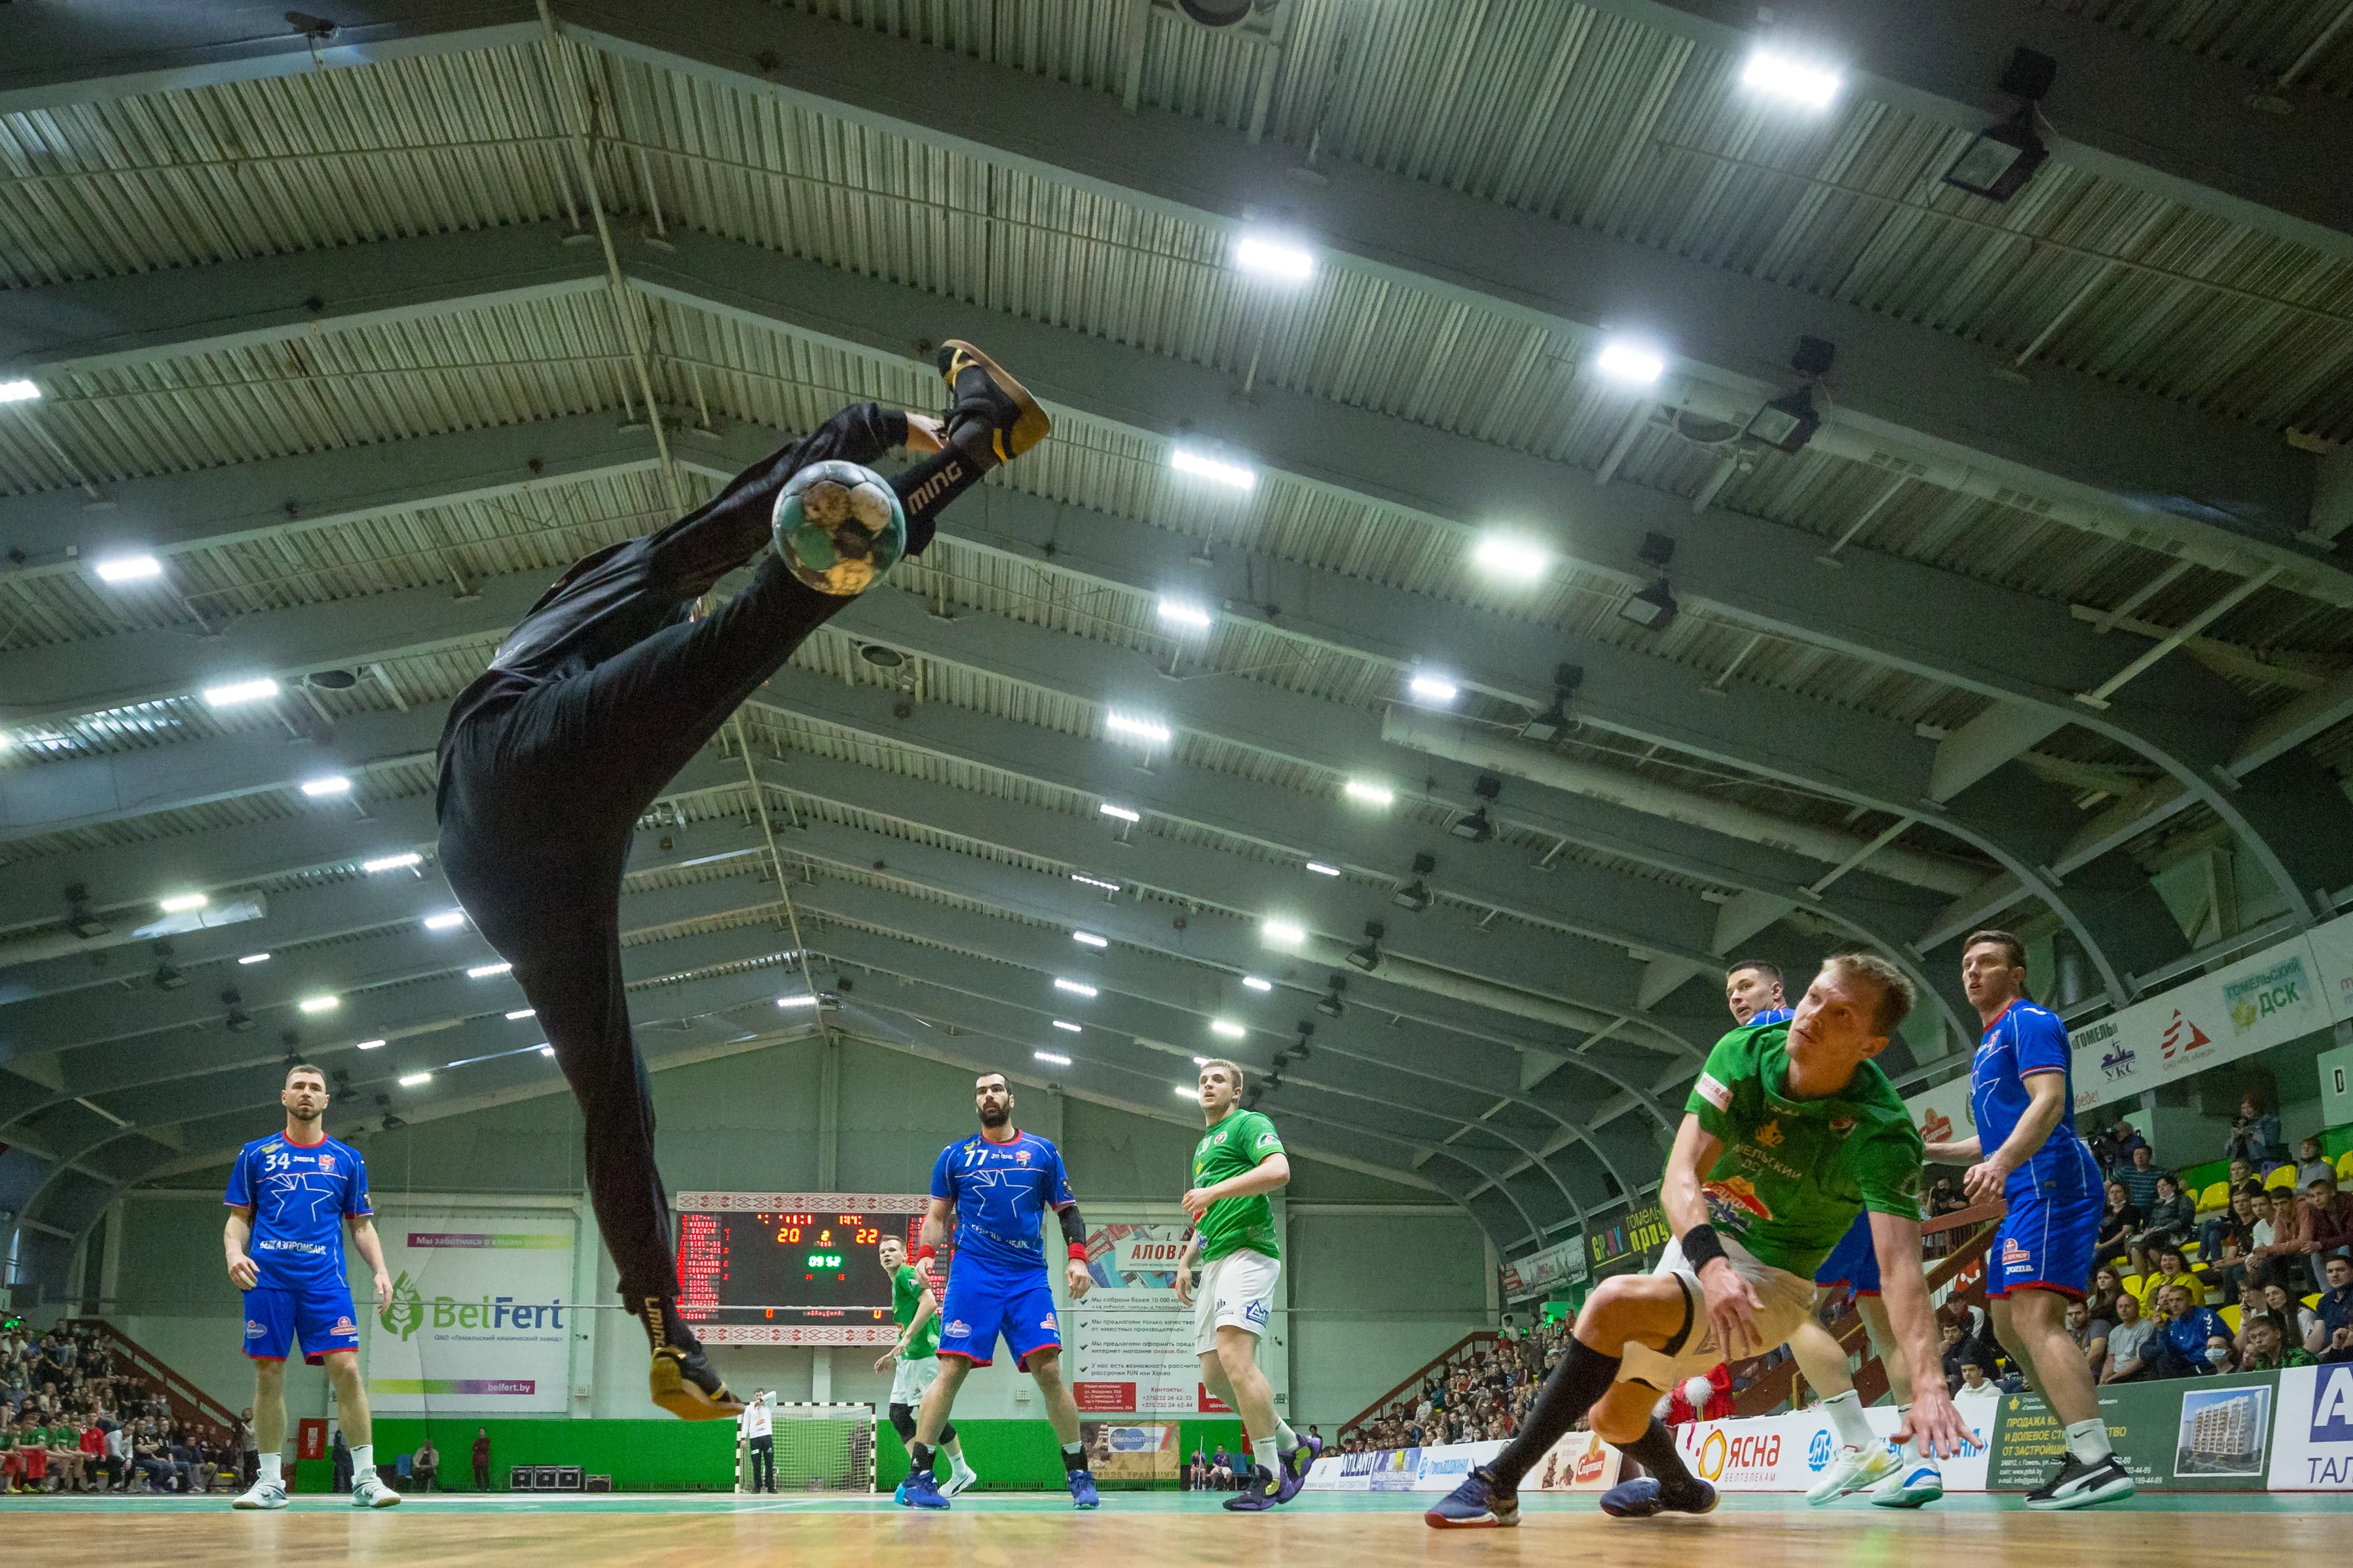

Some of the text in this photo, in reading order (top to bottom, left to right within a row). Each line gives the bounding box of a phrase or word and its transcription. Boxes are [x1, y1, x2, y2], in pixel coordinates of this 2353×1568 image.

[2259, 982, 2301, 1017] ДСК
[2105, 1061, 2137, 1081] УКС
[2335, 1068, 2345, 1093] D
[2074, 1089, 2100, 1109] беде!
[265, 1153, 290, 1171] 34
[965, 1150, 988, 1167] 77
[777, 1228, 800, 1243] 20
[821, 1230, 830, 1241] 2
[855, 1228, 879, 1243] 22
[1131, 1245, 1187, 1260] АЛОВА
[434, 1295, 563, 1328] BelFert
[487, 1383, 530, 1393] belfert.by
[2007, 1416, 2046, 1428] ПРОДАЖА
[2005, 1433, 2010, 1442] И
[2011, 1431, 2050, 1442] ДОЛЕВОЕ
[2003, 1444, 2067, 1456] ОТ ЗАСТРОЙЩИ
[1725, 1472, 1776, 1483] БЕЛТЭЛЕКАМ
